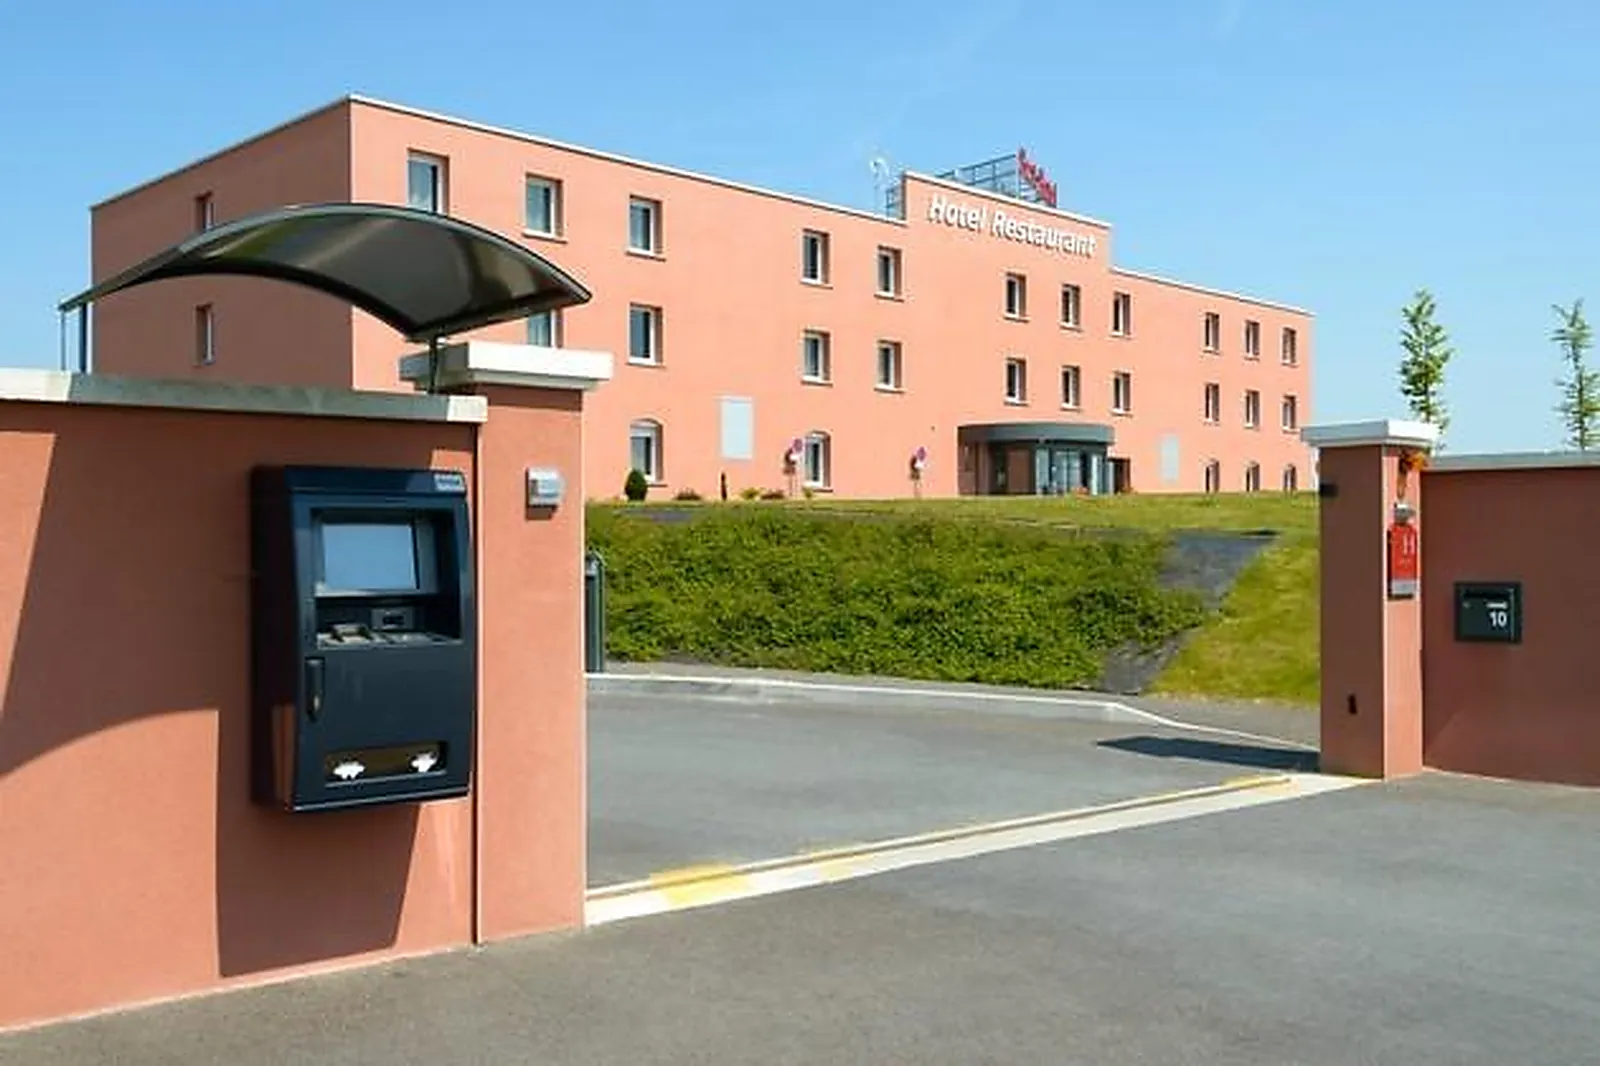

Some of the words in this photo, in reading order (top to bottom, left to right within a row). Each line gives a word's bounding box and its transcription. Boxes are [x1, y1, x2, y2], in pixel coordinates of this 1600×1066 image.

[929, 194, 986, 233] Hotel
[990, 209, 1096, 257] Restaurant
[1489, 611, 1507, 628] 10
